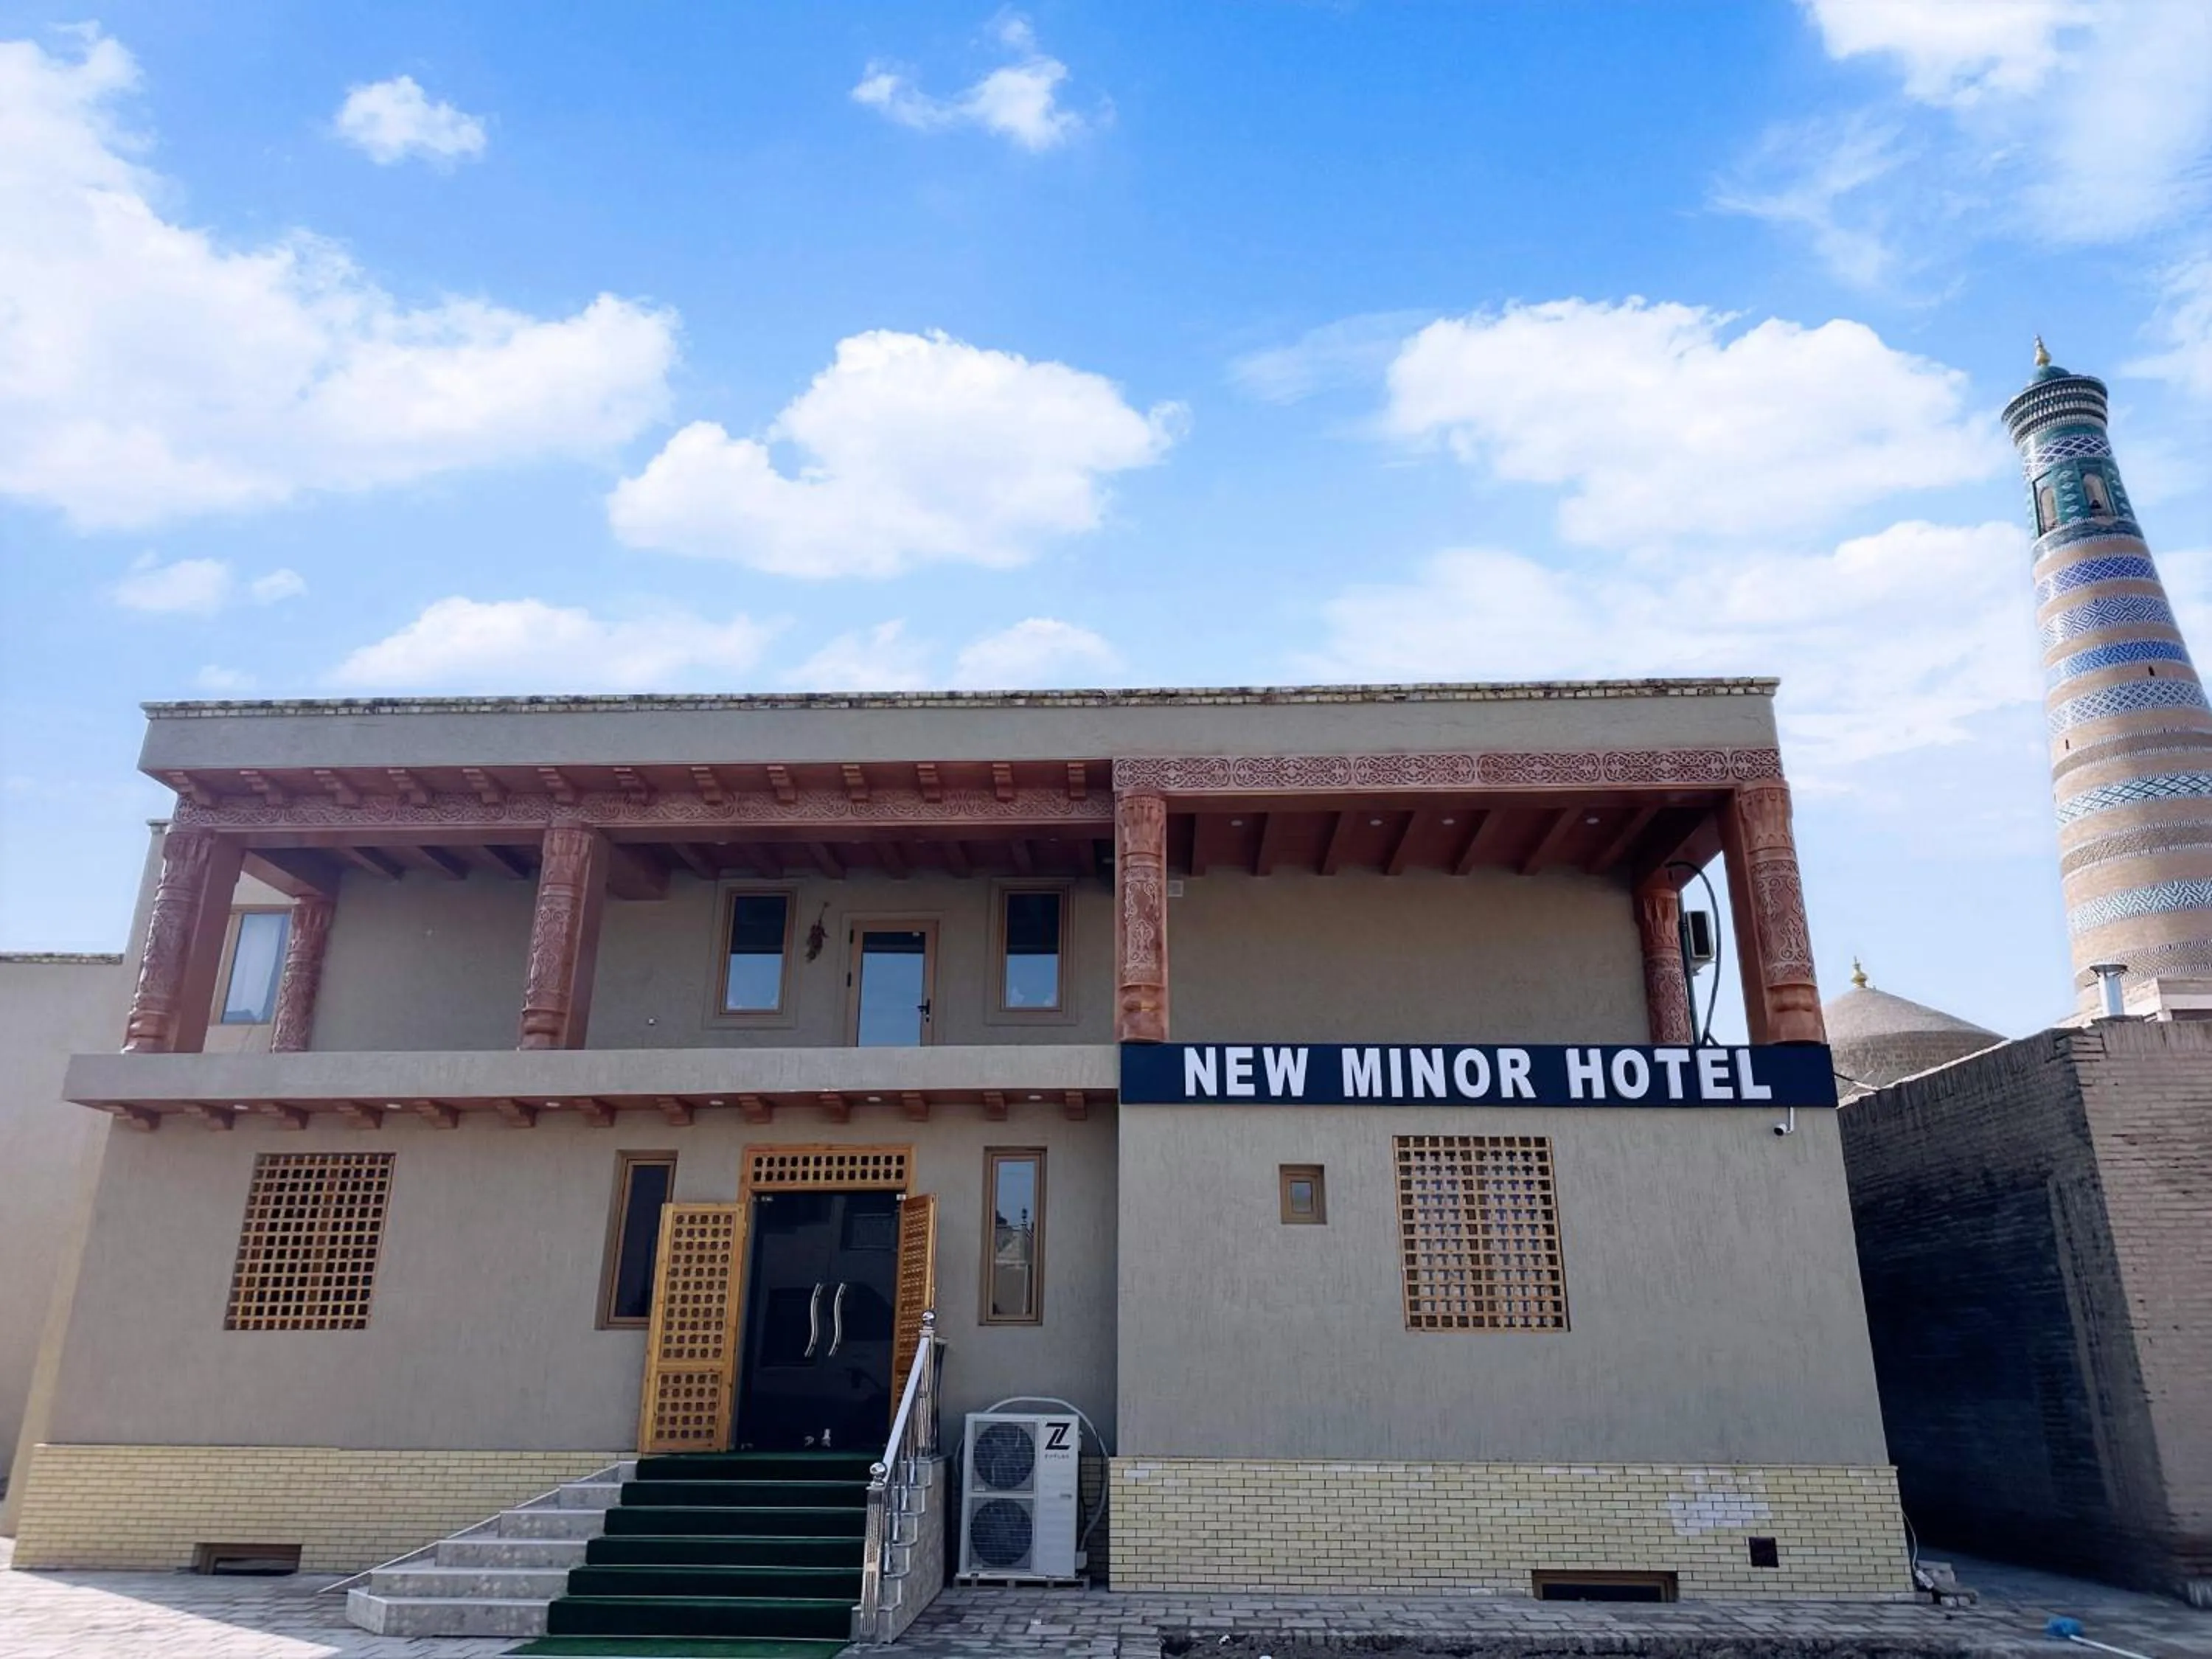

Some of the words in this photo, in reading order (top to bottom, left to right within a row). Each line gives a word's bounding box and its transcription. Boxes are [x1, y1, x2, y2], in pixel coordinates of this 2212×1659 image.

[1183, 1046, 1309, 1097] NEW
[1341, 1047, 1537, 1099] MINOR
[1565, 1048, 1773, 1099] HOTEL
